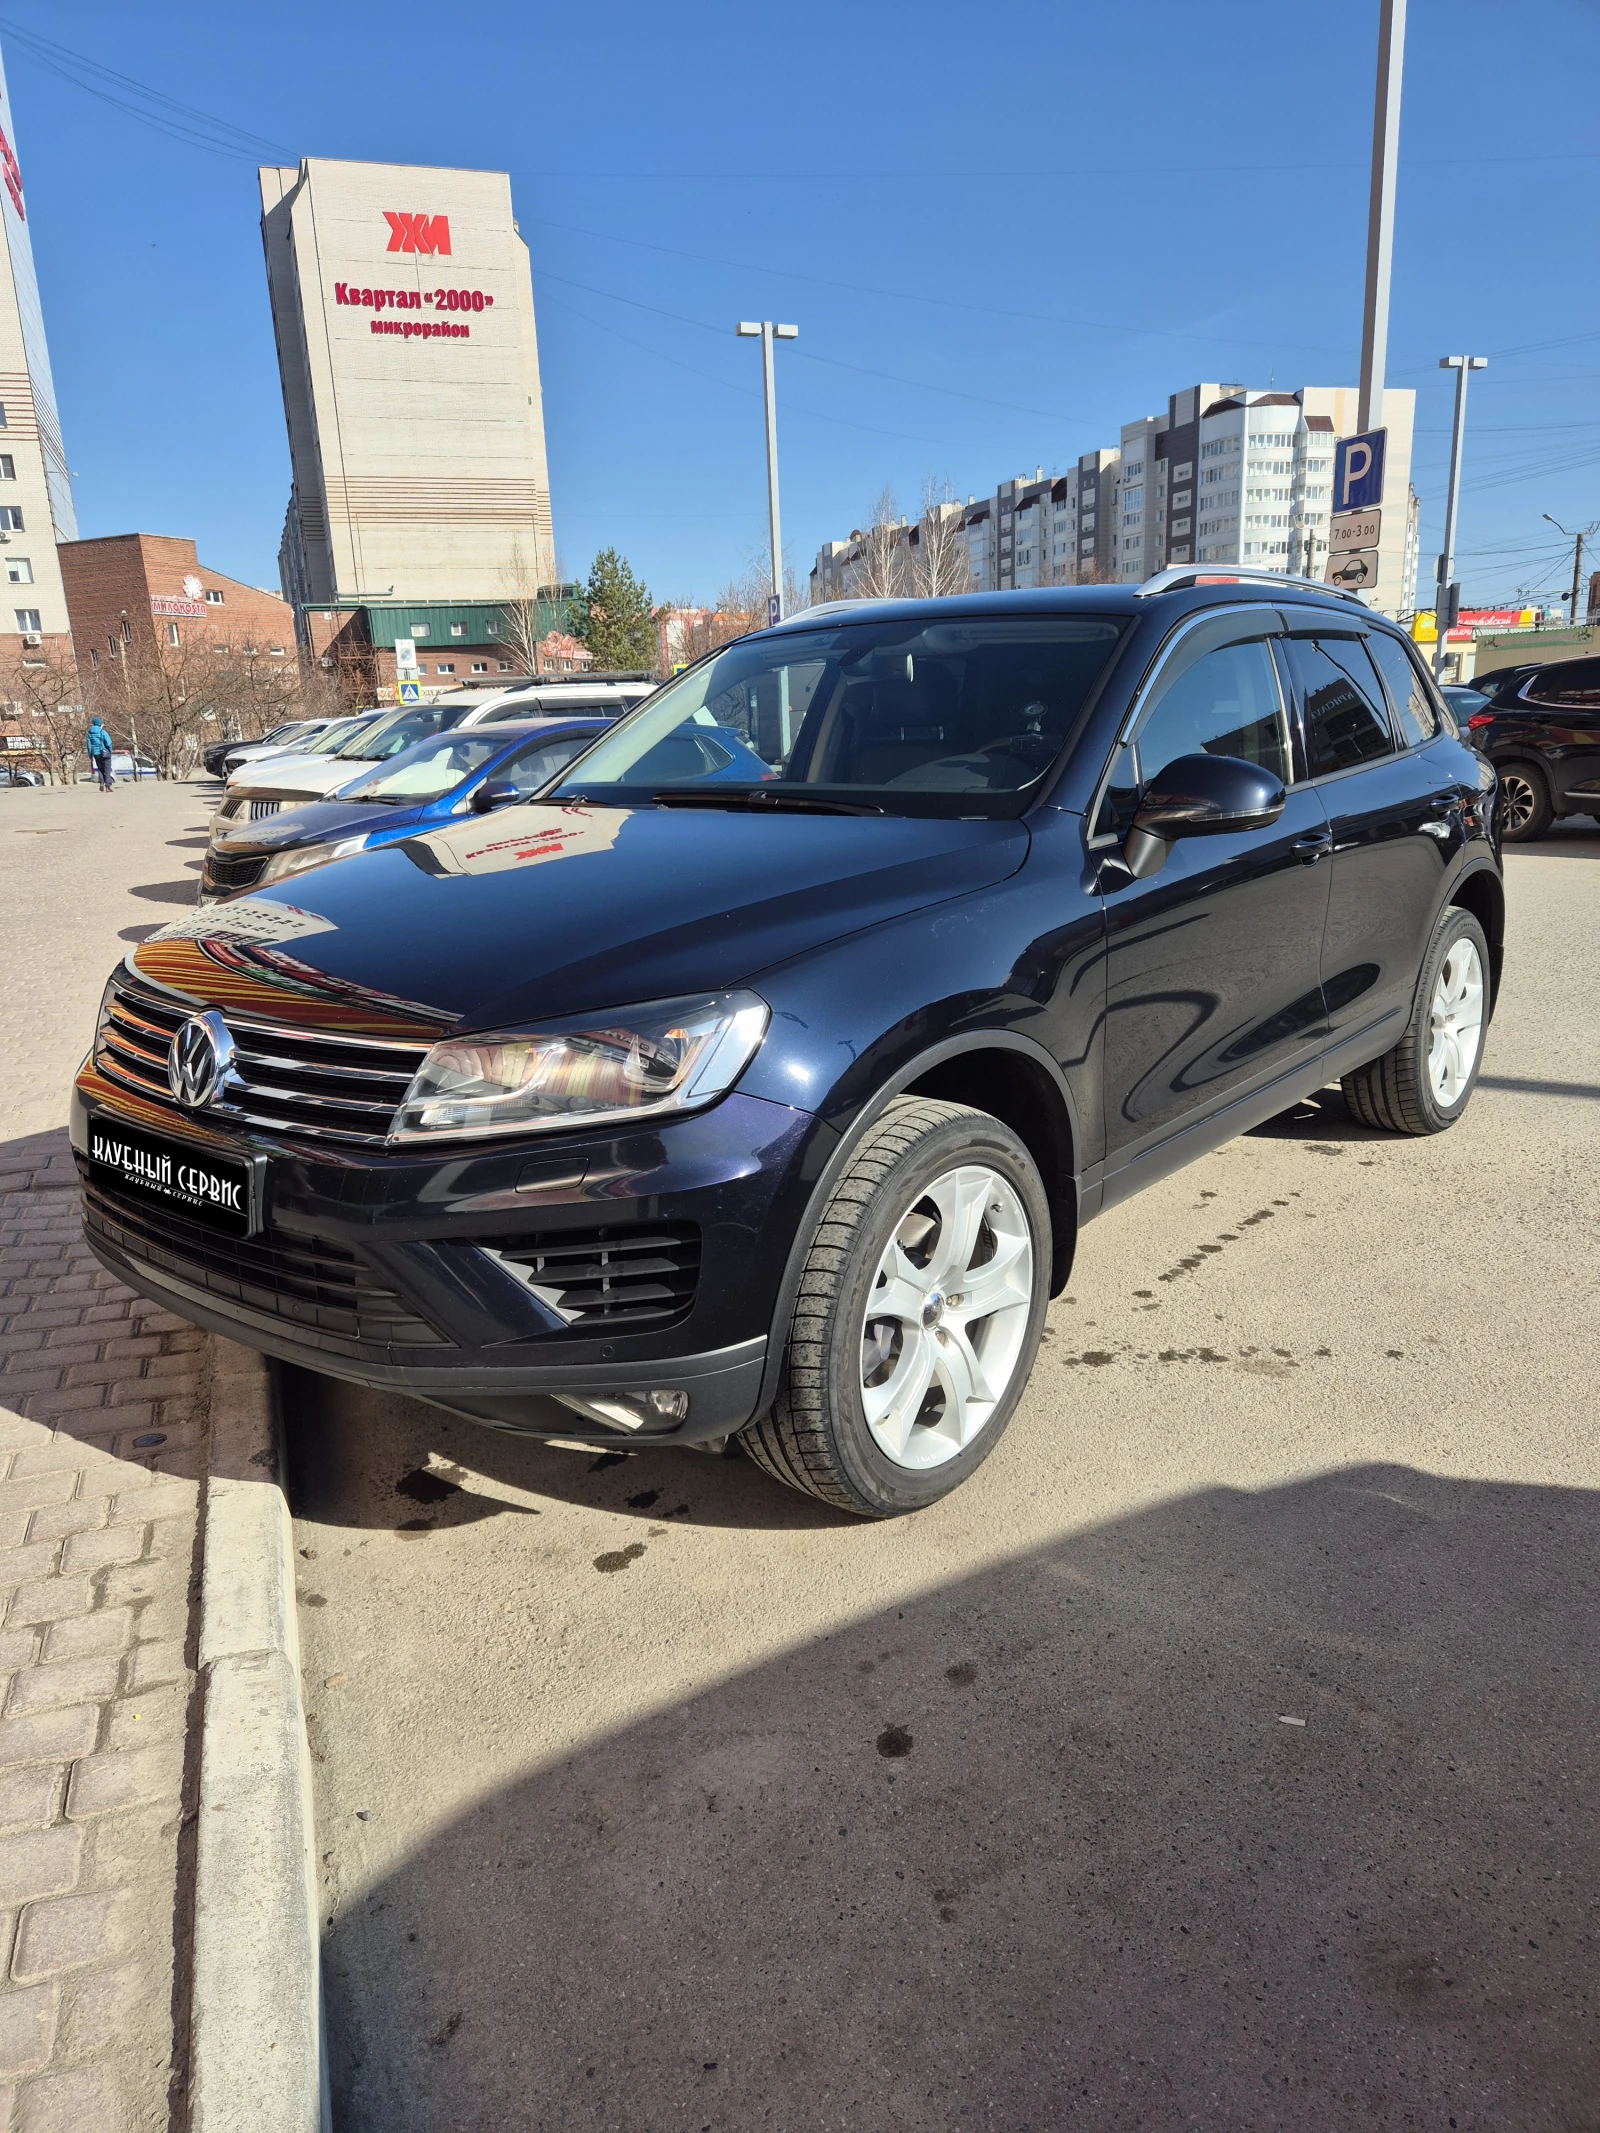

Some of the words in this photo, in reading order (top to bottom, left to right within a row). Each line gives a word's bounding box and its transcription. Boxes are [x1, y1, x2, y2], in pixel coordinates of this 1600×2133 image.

[334, 282, 421, 312] Квартал
[424, 289, 494, 312] «2000»
[370, 320, 470, 339] микрорайон
[1343, 442, 1372, 505] P
[1334, 524, 1375, 541] 7.00-3.00
[770, 599, 778, 626] P
